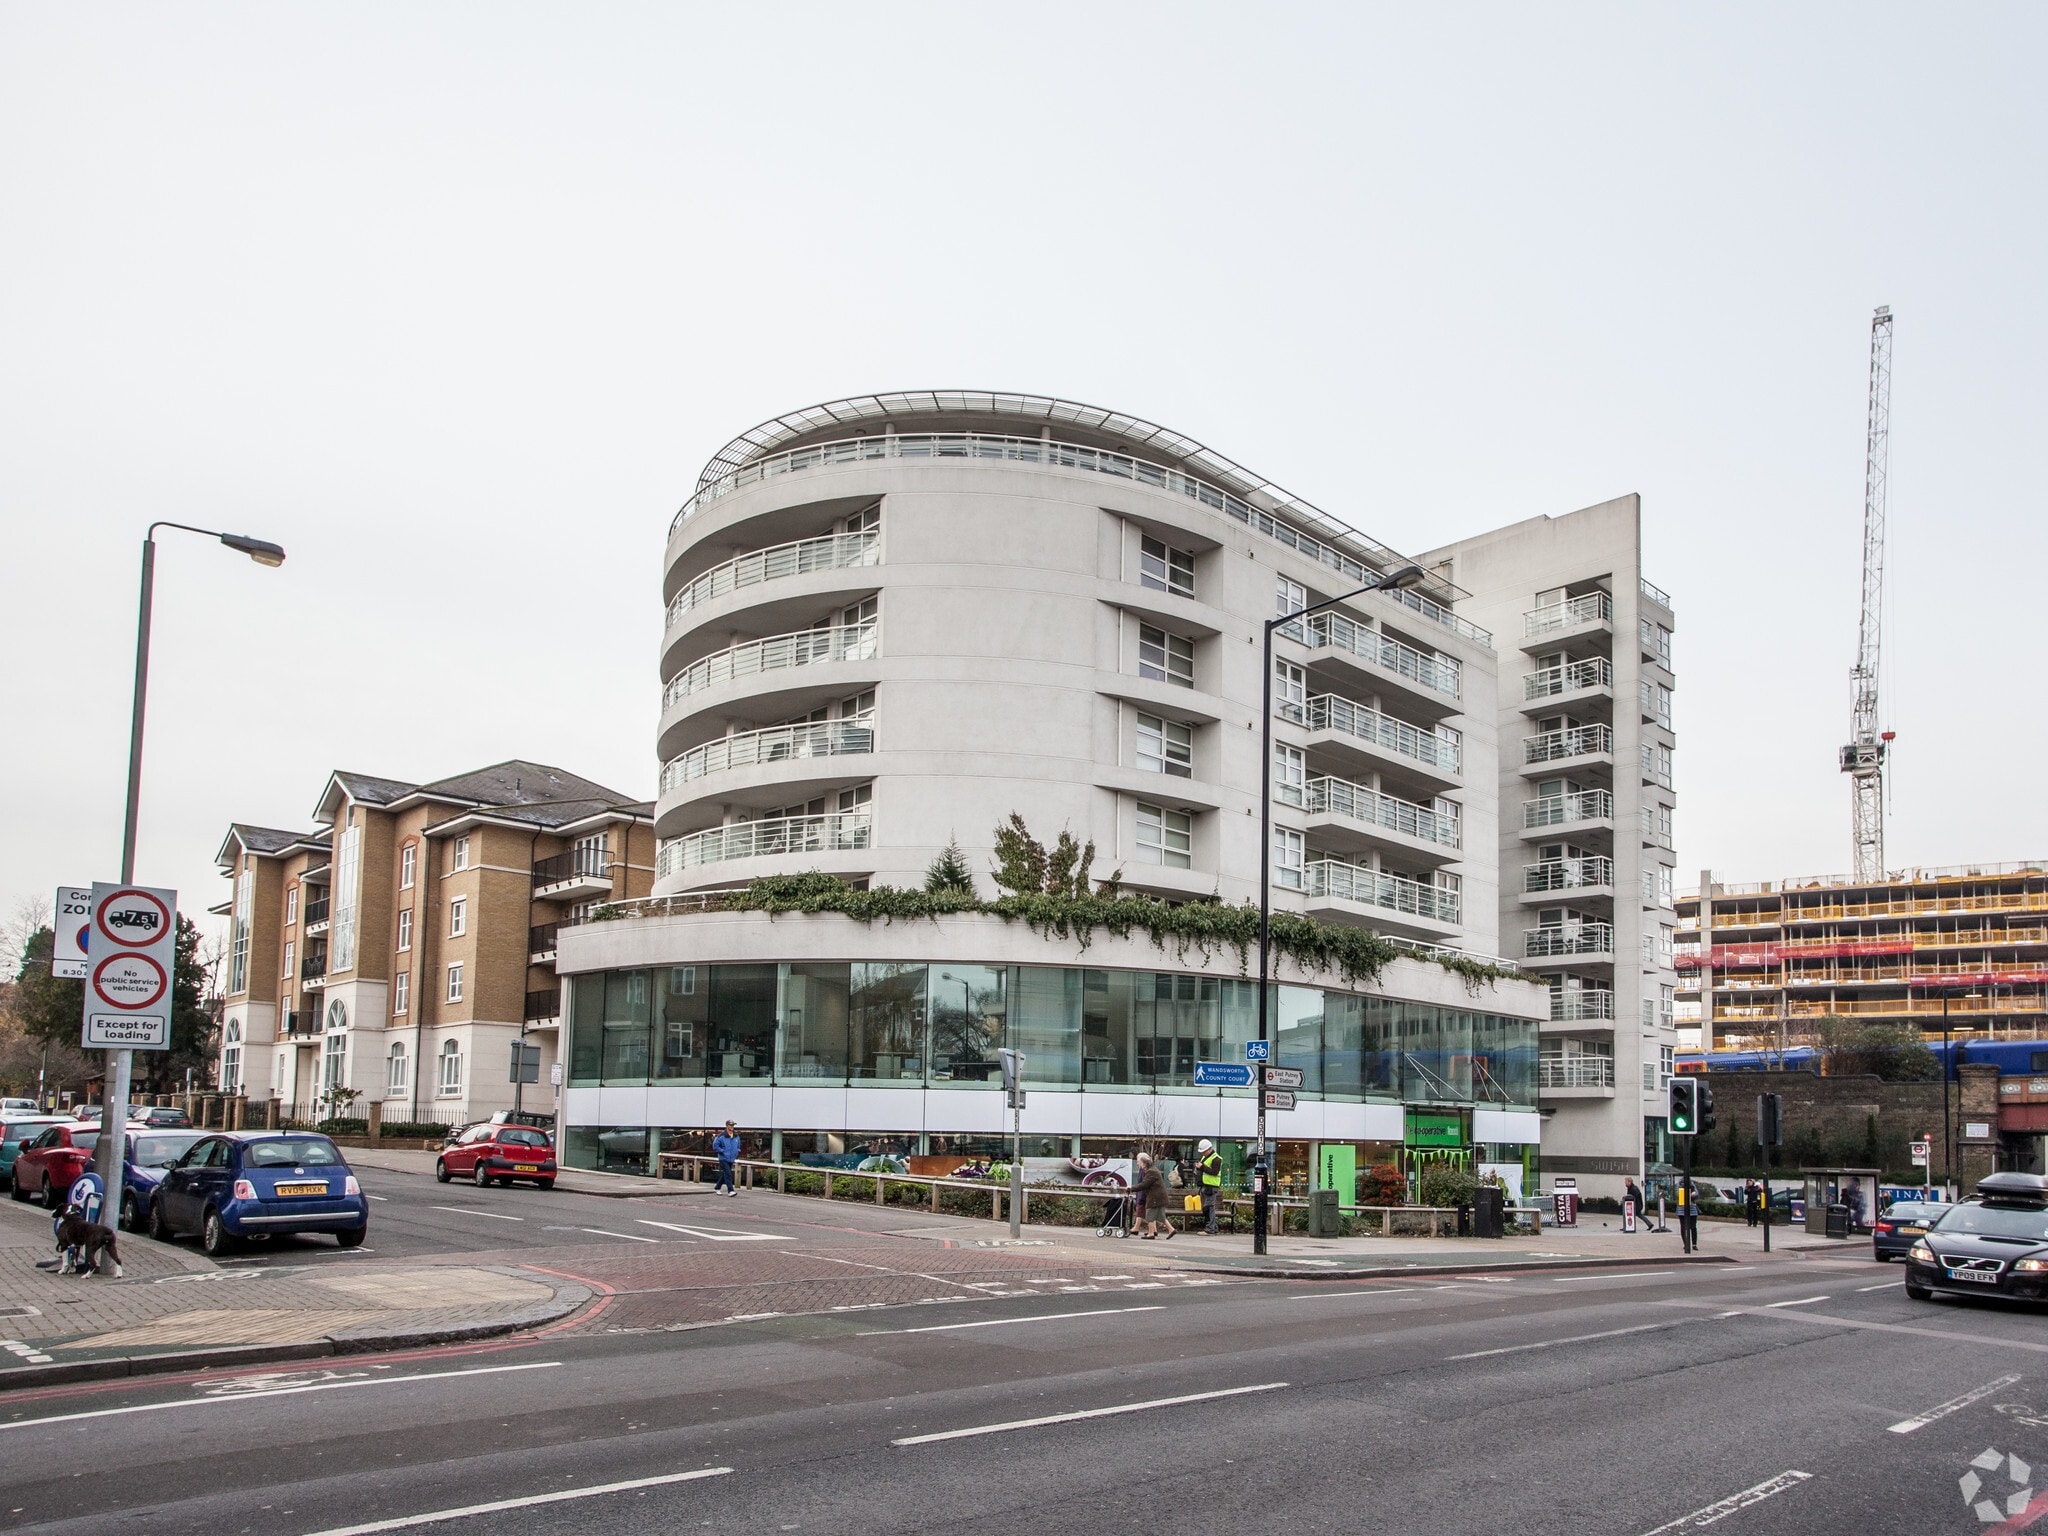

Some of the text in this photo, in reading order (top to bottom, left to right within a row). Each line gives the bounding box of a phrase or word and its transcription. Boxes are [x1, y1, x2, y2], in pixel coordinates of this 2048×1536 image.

[112, 985, 149, 993] vehicles
[97, 1020, 159, 1030] Except for
[105, 1030, 151, 1041] loading
[1284, 1071, 1299, 1079] Putney
[1276, 1093, 1290, 1101] Putney
[281, 1187, 304, 1195] RV09
[1557, 1194, 1565, 1222] COSTA
[1952, 1271, 1995, 1283] YP09 EFK
